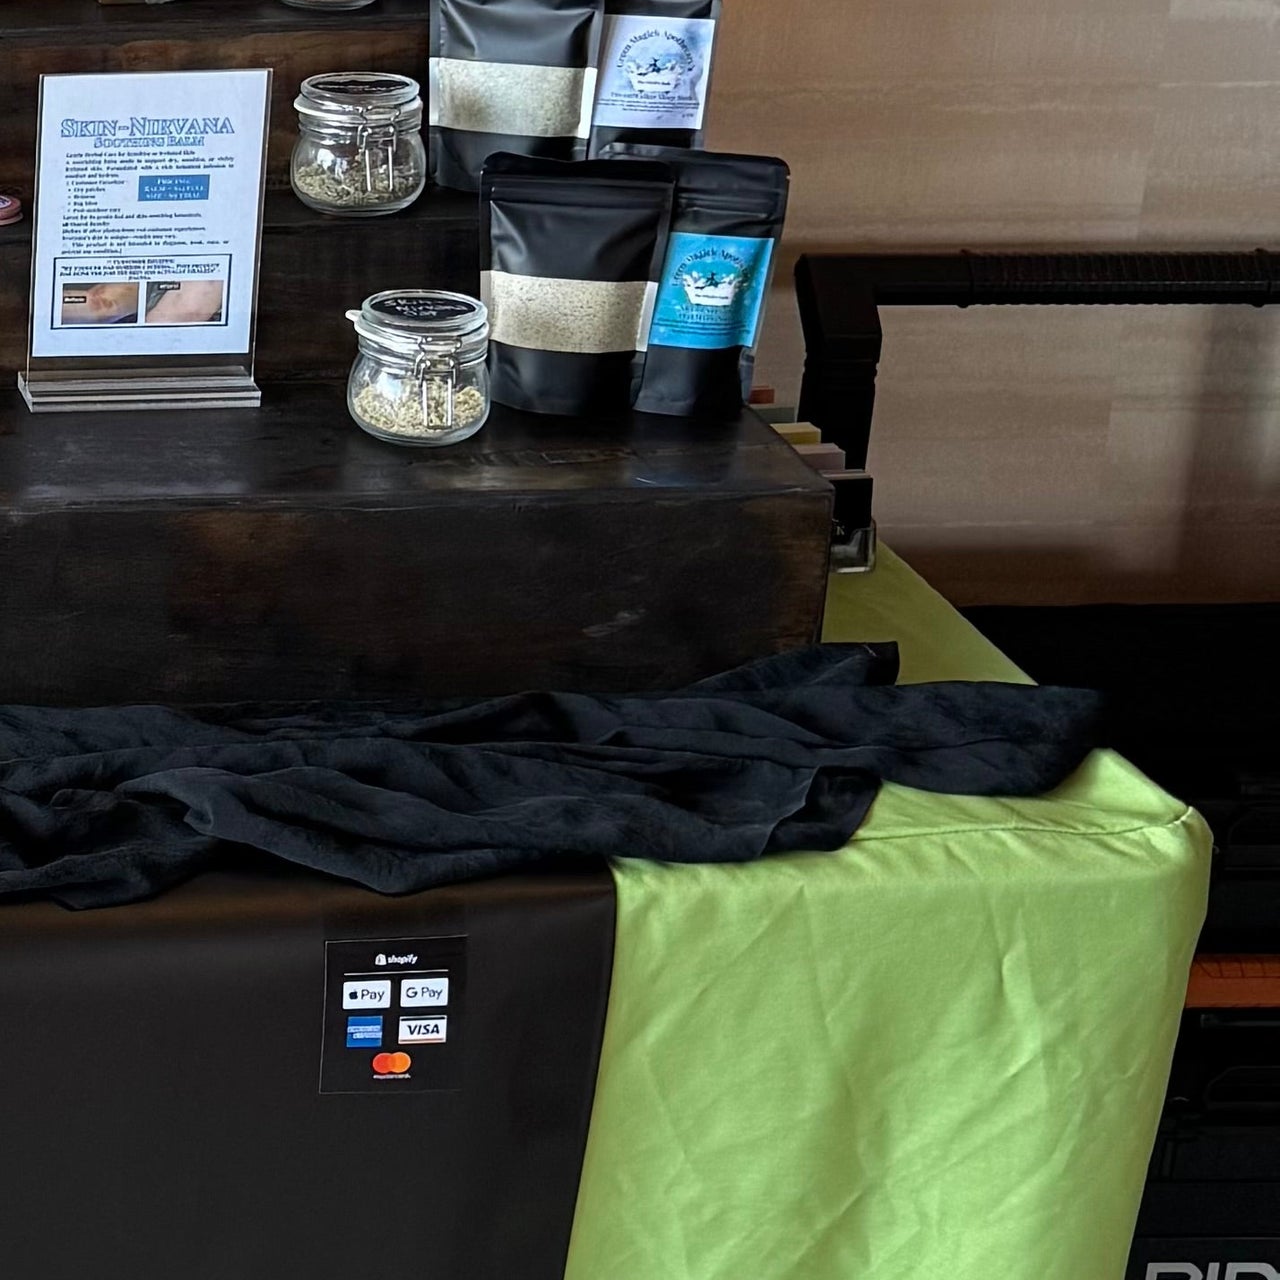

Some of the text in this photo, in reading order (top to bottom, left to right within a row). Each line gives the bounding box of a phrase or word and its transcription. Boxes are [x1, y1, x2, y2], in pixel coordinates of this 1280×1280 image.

[60, 117, 235, 137] SKIN-NIRVANA
[361, 989, 384, 1003] Pay
[421, 987, 443, 1000] Pay
[407, 1024, 440, 1035] VISA
